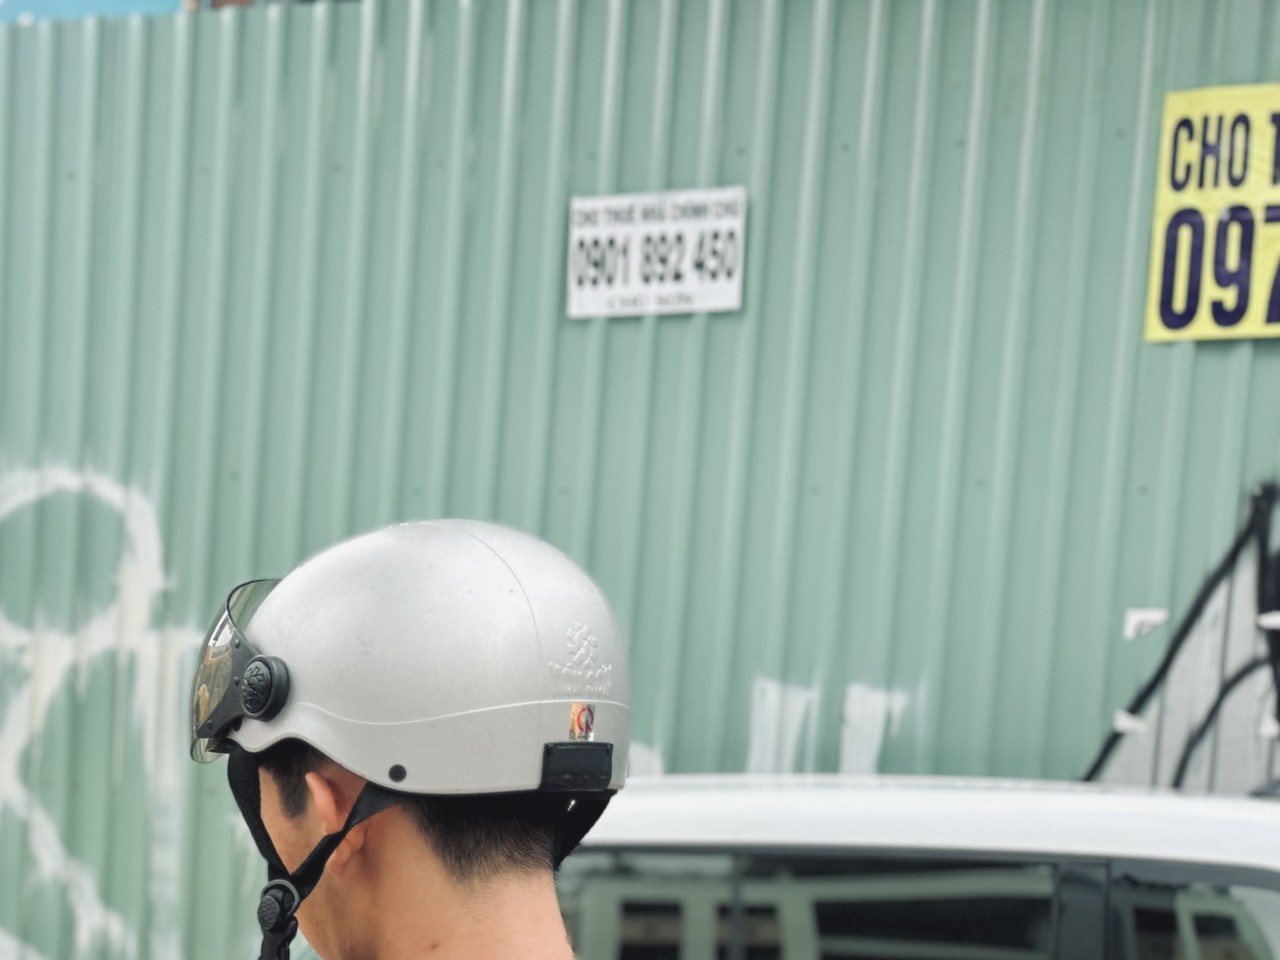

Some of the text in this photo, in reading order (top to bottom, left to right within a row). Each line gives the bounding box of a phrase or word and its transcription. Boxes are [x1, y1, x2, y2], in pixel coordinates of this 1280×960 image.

[1170, 113, 1251, 192] CHO
[573, 228, 738, 288] 0901 892 450
